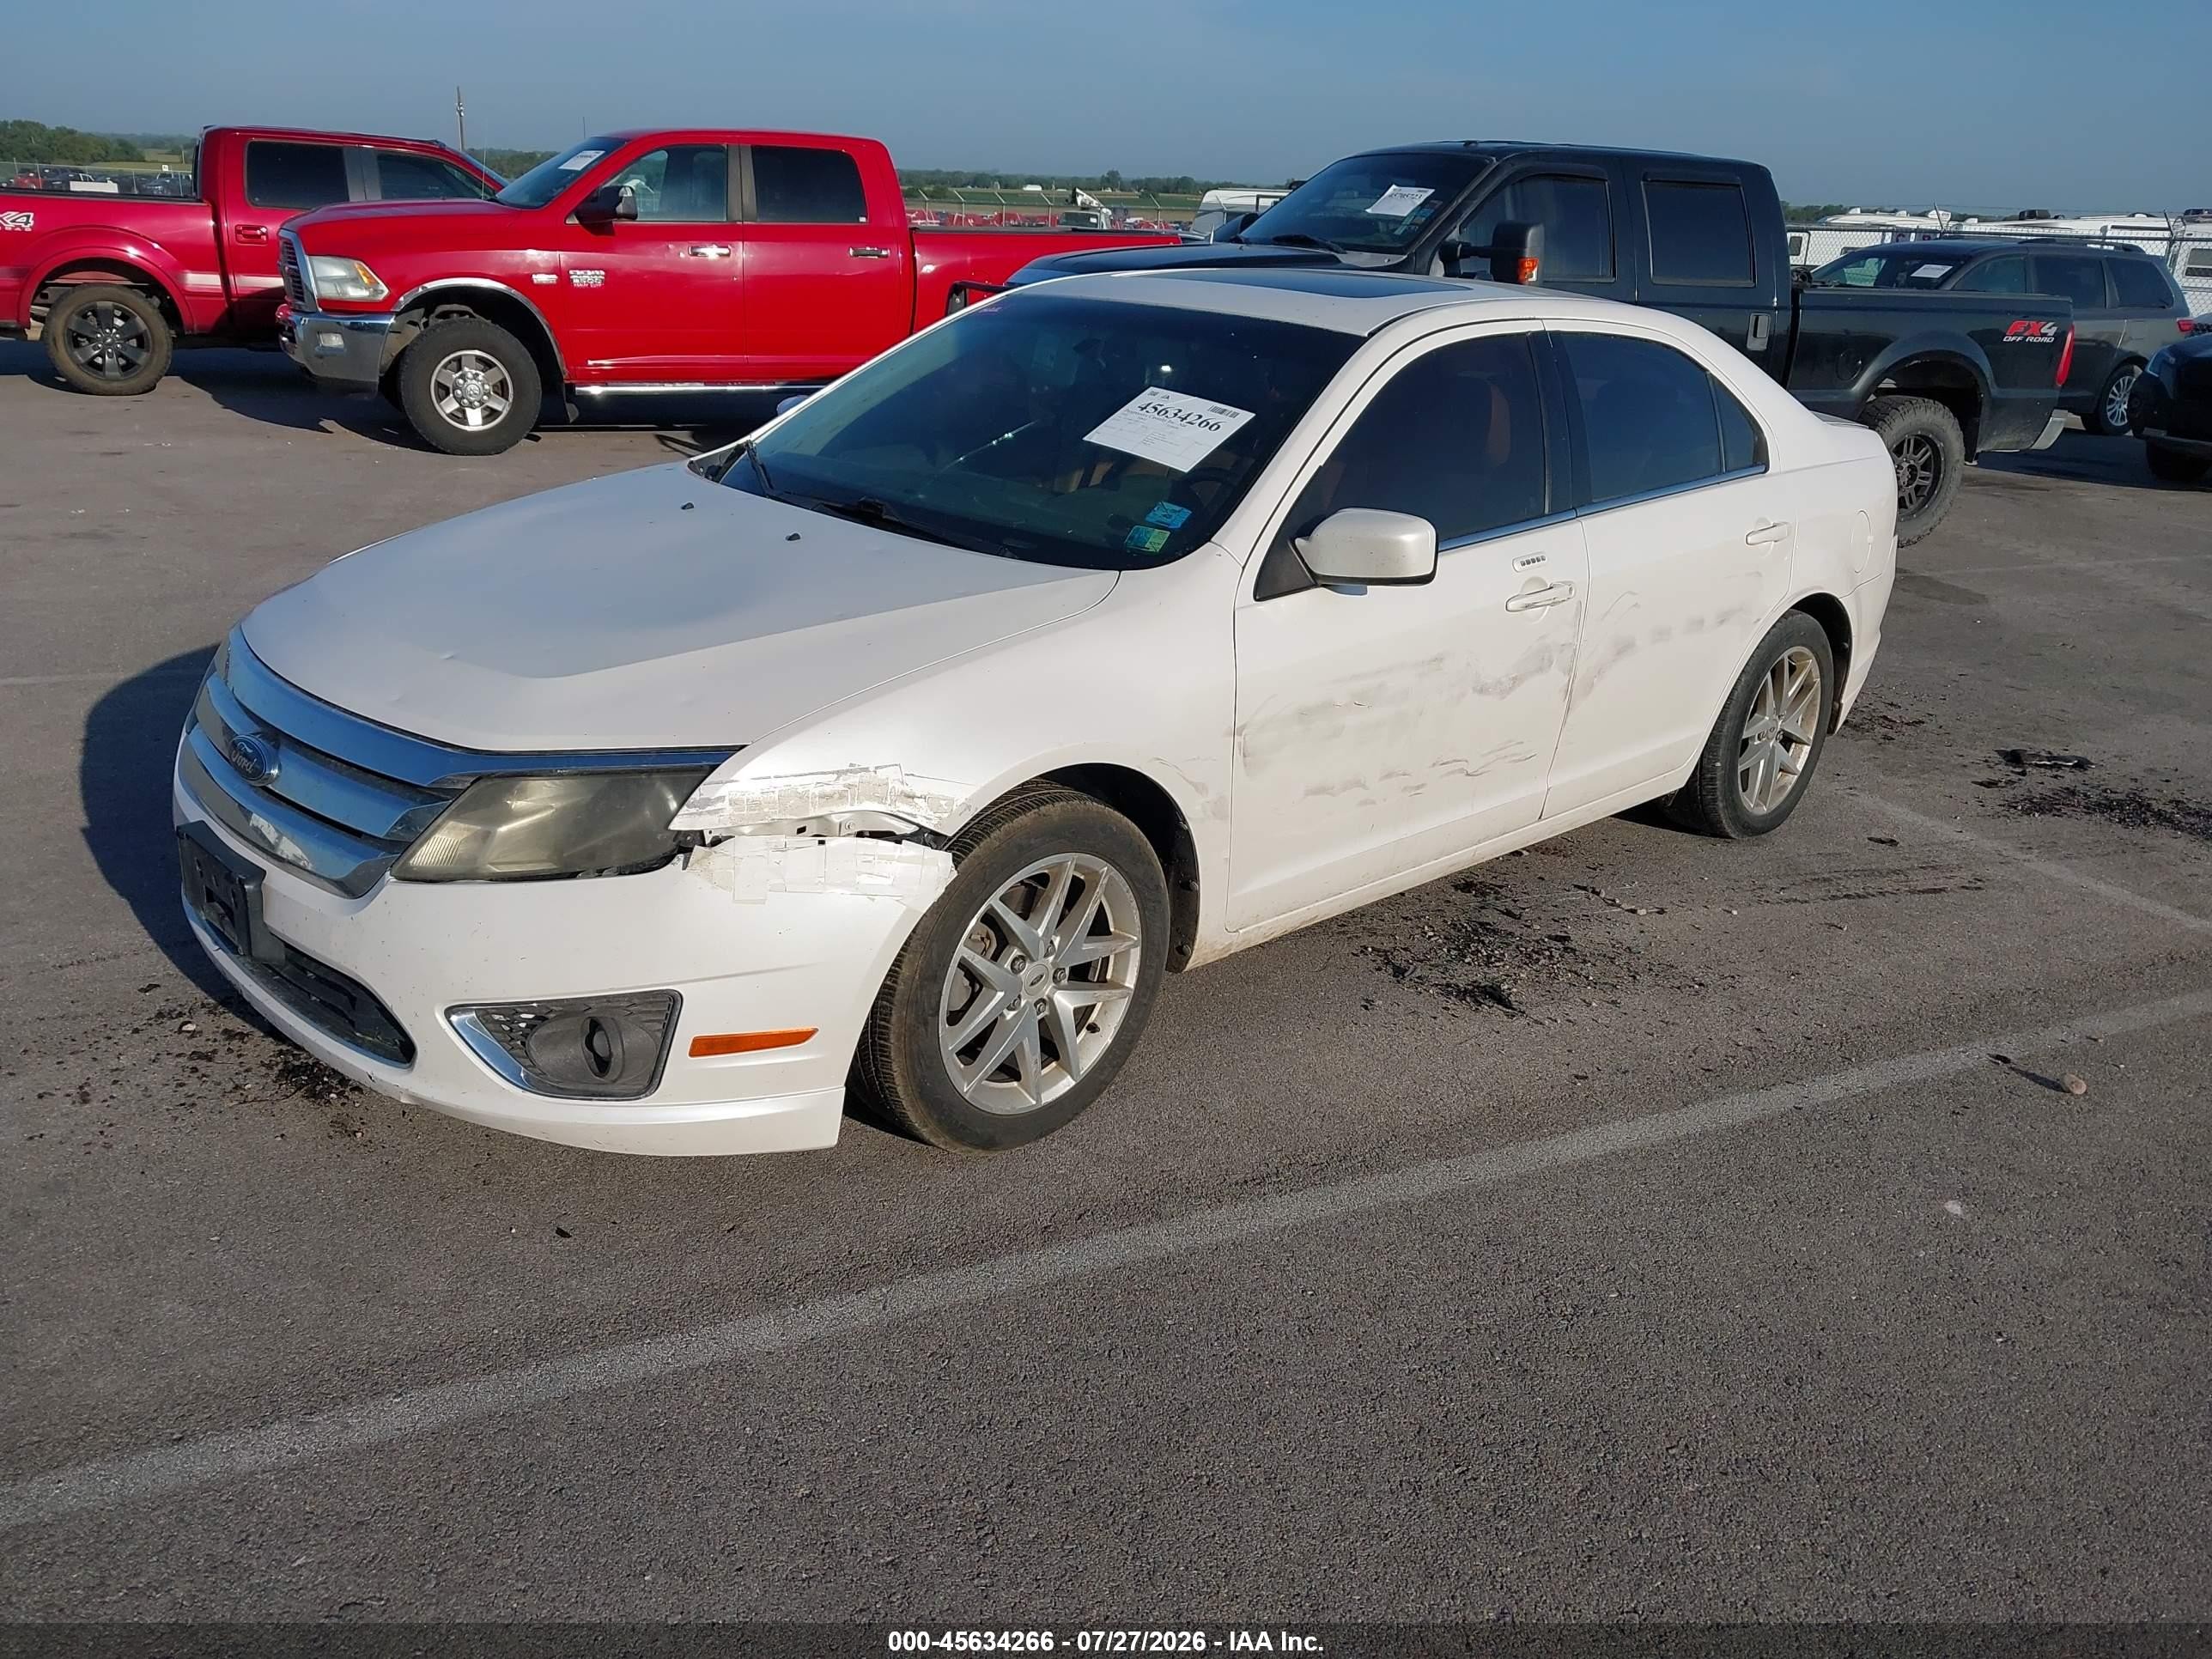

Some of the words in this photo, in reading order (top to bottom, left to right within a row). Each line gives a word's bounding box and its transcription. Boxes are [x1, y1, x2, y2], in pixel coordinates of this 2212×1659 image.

[0, 211, 34, 228] X4
[2006, 320, 2058, 336] FX4
[1138, 402, 1227, 431] 45634266
[231, 741, 258, 773] Ford
